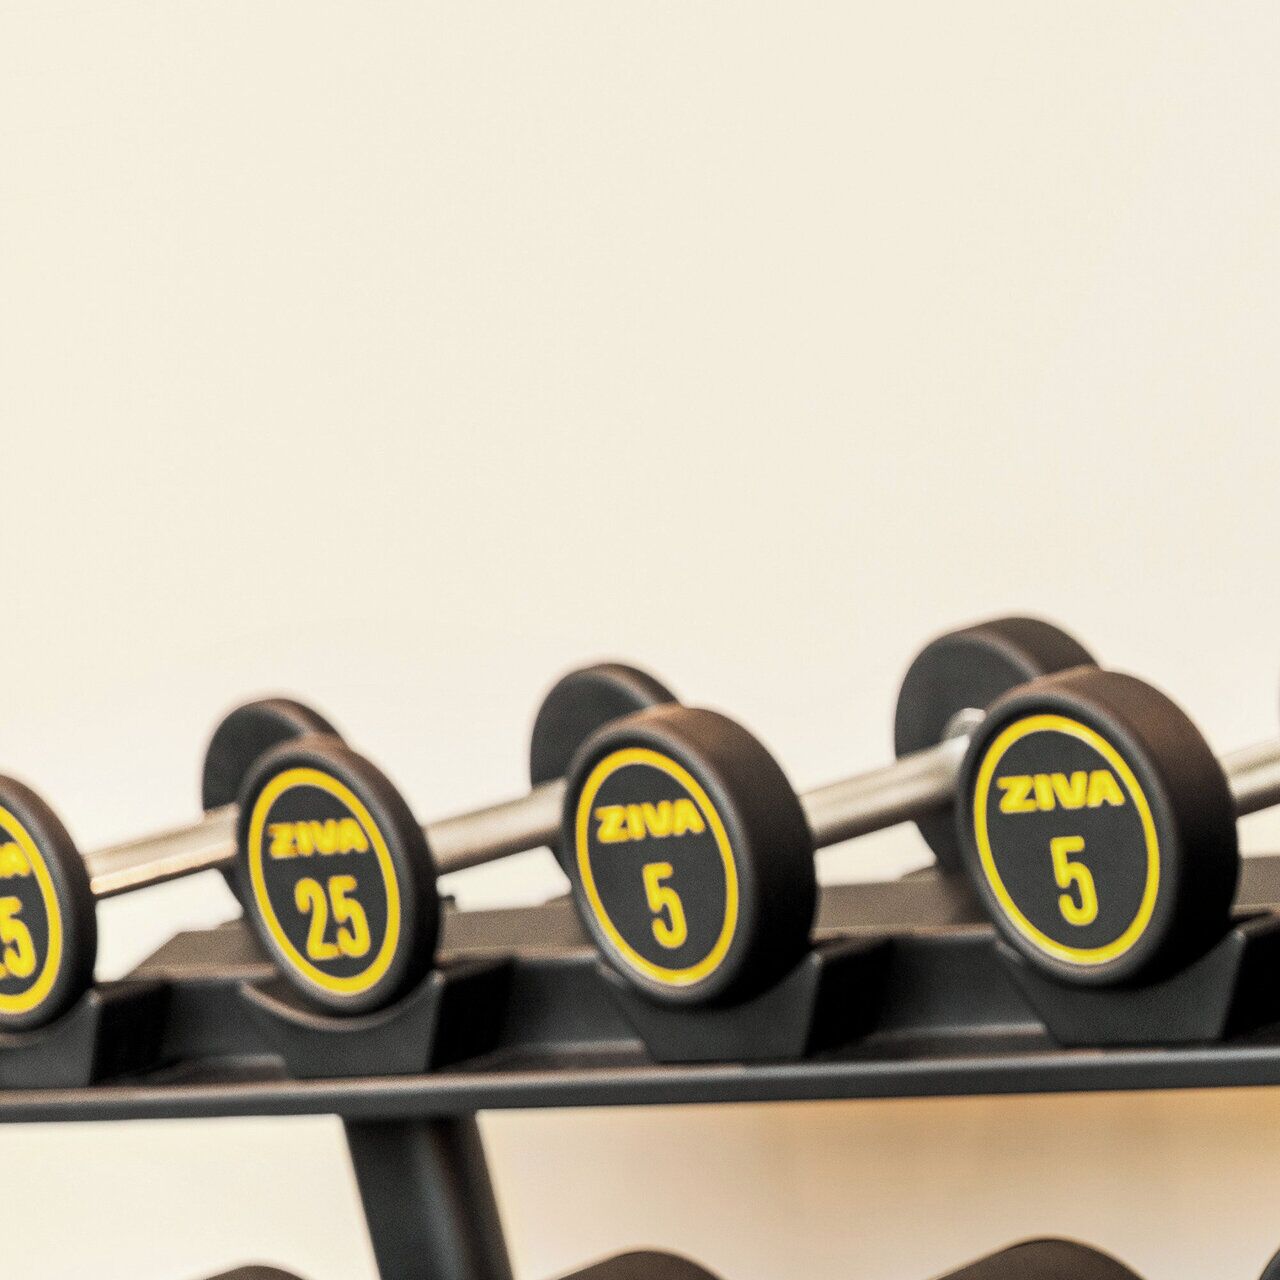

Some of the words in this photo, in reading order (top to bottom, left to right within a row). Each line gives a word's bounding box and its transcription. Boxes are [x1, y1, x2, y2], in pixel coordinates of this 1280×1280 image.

[997, 769, 1126, 813] ZIVA
[269, 817, 370, 859] ZIVA
[595, 799, 705, 843] ZIVA
[1049, 835, 1098, 925] 5
[642, 863, 688, 948] 5
